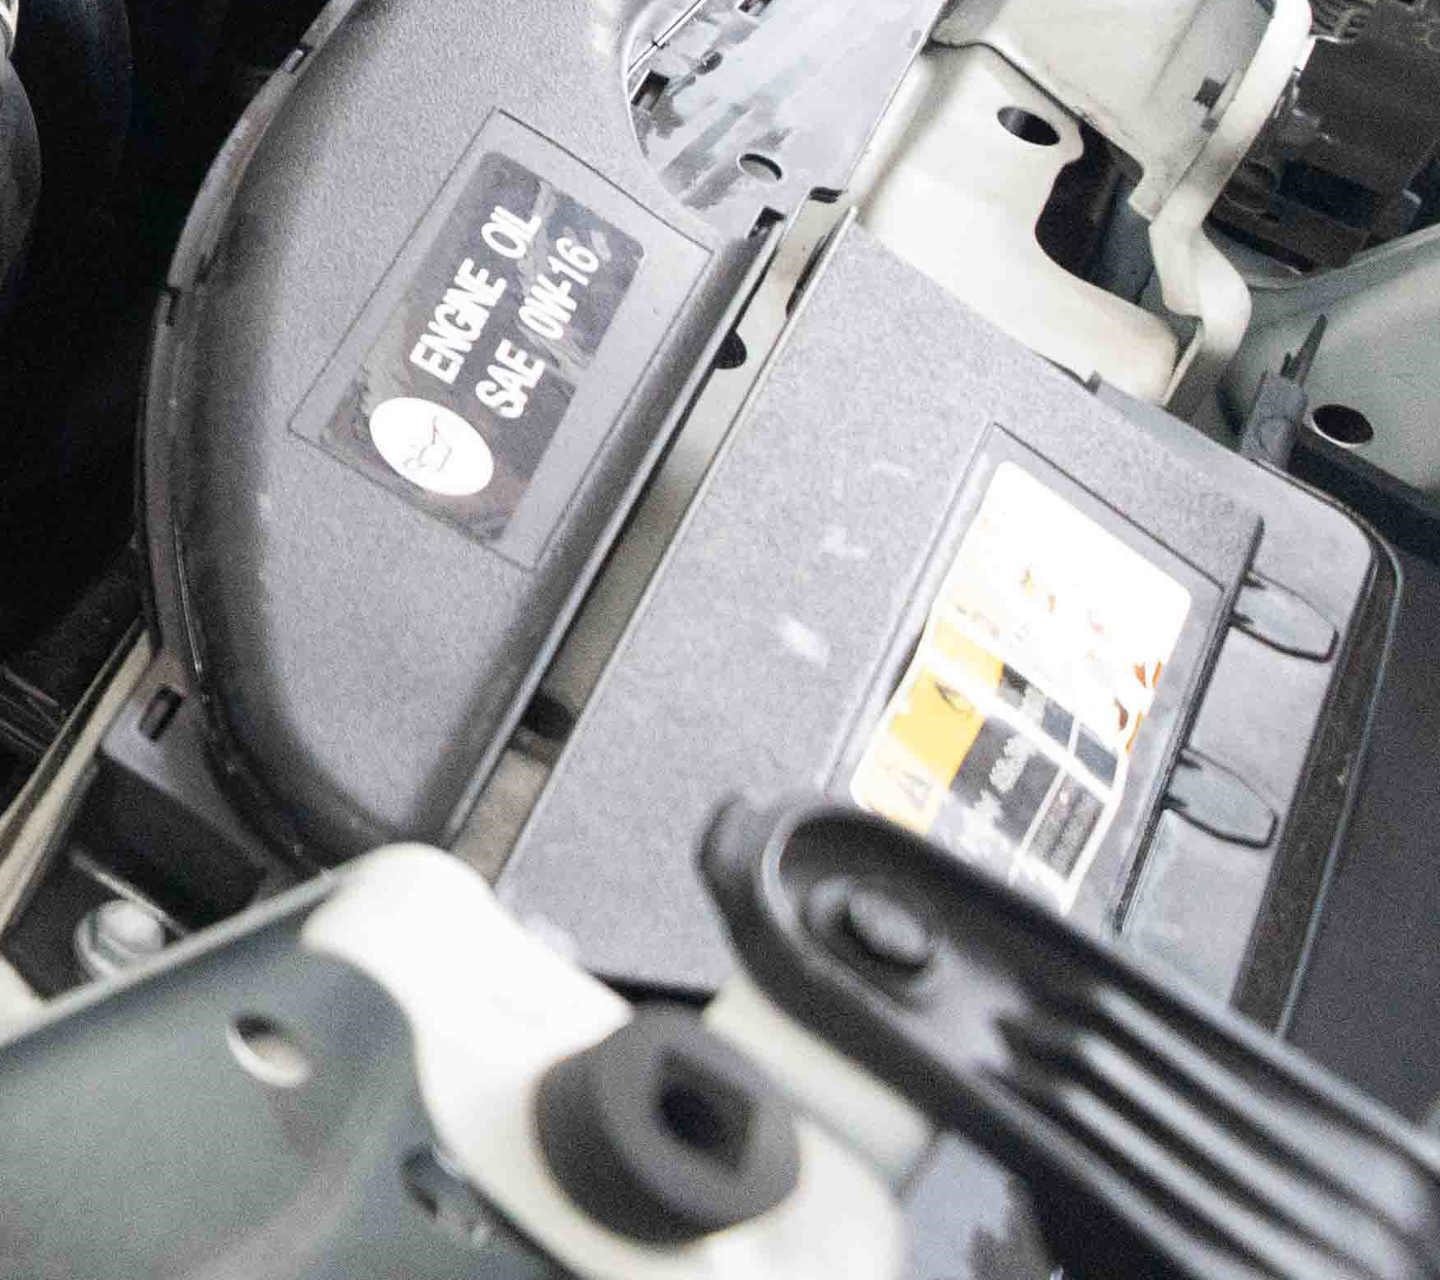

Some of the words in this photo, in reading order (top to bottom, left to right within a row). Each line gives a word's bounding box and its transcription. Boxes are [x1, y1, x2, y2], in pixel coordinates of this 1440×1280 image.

[409, 257, 508, 385] ENGINE
[481, 205, 542, 260] OIL
[475, 338, 546, 419] SAE
[518, 236, 600, 340] 0W-16
